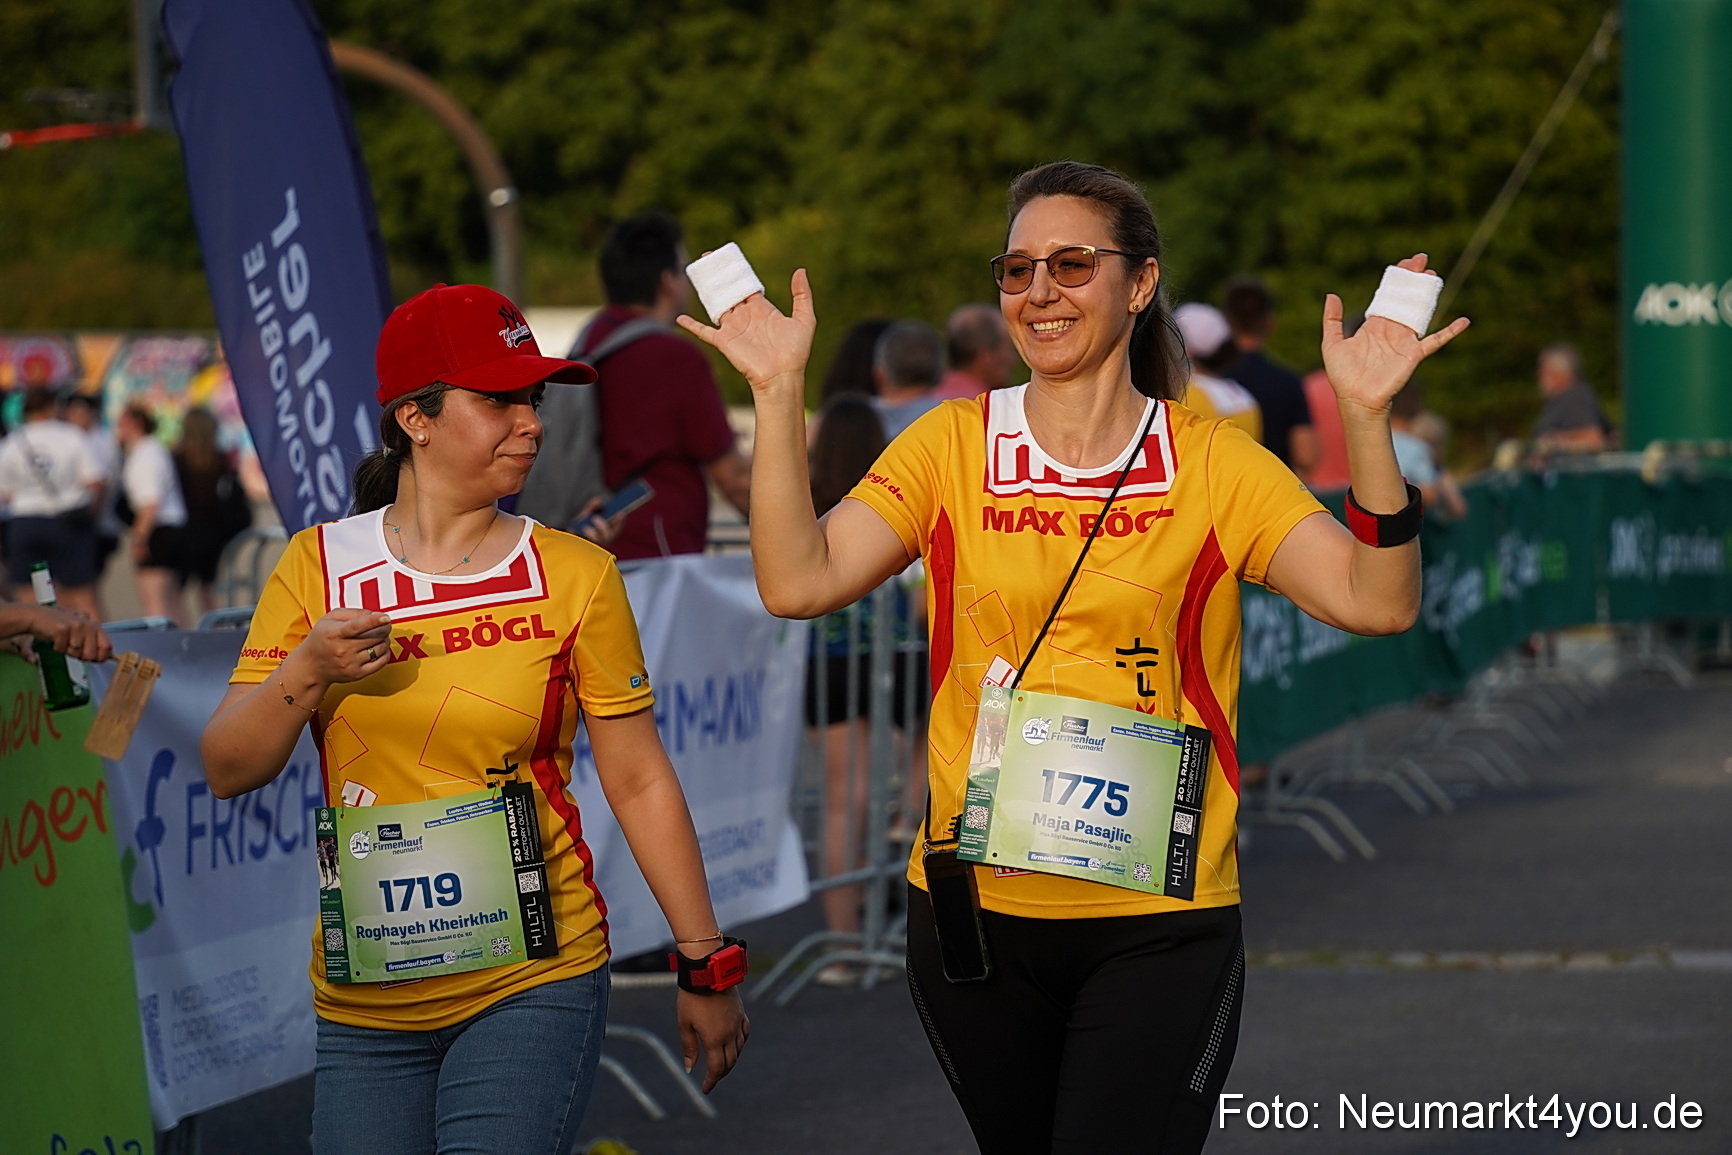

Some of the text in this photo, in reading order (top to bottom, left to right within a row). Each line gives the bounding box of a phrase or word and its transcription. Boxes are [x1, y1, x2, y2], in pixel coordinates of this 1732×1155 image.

[1633, 282, 1719, 326] AOK
[982, 506, 1066, 536] MAX
[442, 613, 556, 654] BÖGL
[984, 699, 1006, 710] AOK
[1051, 732, 1106, 747] Firmenlauf
[1071, 743, 1104, 753] neumarkt
[1190, 738, 1201, 768] OUTLET
[1177, 789, 1185, 802] 20
[1181, 735, 1193, 777] RABATT
[1042, 768, 1130, 817] 1775
[1186, 768, 1197, 803] FACTORY
[318, 821, 333, 830] AOK
[505, 797, 518, 837] RABATT
[515, 796, 525, 825] OUTLET
[373, 836, 423, 851] Firmenlauf
[1032, 812, 1132, 844] Maja Pasajlic
[393, 845, 423, 855] neumarkt
[514, 850, 522, 863] 20
[519, 828, 530, 861] FACTORY
[1030, 853, 1086, 867] firmenlauf.bayern
[1171, 839, 1185, 887] HILTL
[378, 872, 462, 913] 1719
[356, 908, 508, 941] Roghayeh Kheirkhah
[526, 897, 543, 947] HILTL
[388, 957, 441, 971] firmenlauf.bayern
